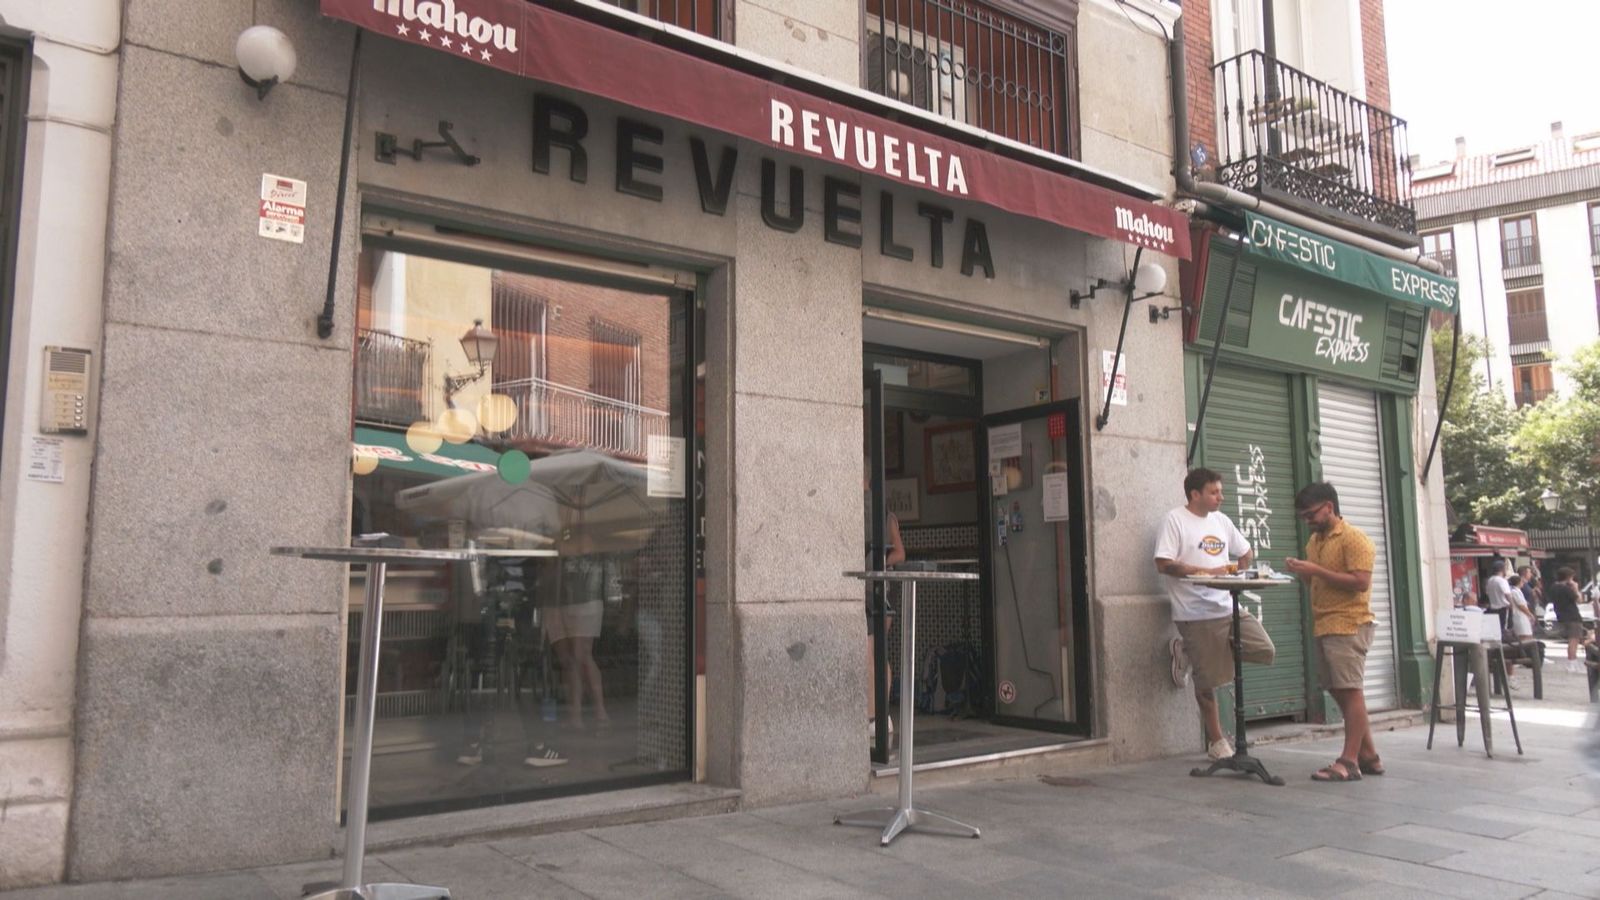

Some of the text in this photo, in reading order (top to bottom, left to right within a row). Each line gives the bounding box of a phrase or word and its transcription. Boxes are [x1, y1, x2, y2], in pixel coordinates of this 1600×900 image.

[770, 99, 968, 195] REVUELTA
[262, 200, 304, 217] Alarma
[532, 93, 996, 279] REVUELTA
[1115, 206, 1174, 244] Mahou
[1252, 219, 1457, 307] CAFESTIC EXPRESS
[1279, 294, 1363, 343] CAFESTIC
[1315, 336, 1370, 364] EXPRESS
[1249, 443, 1272, 550] EXPRESS
